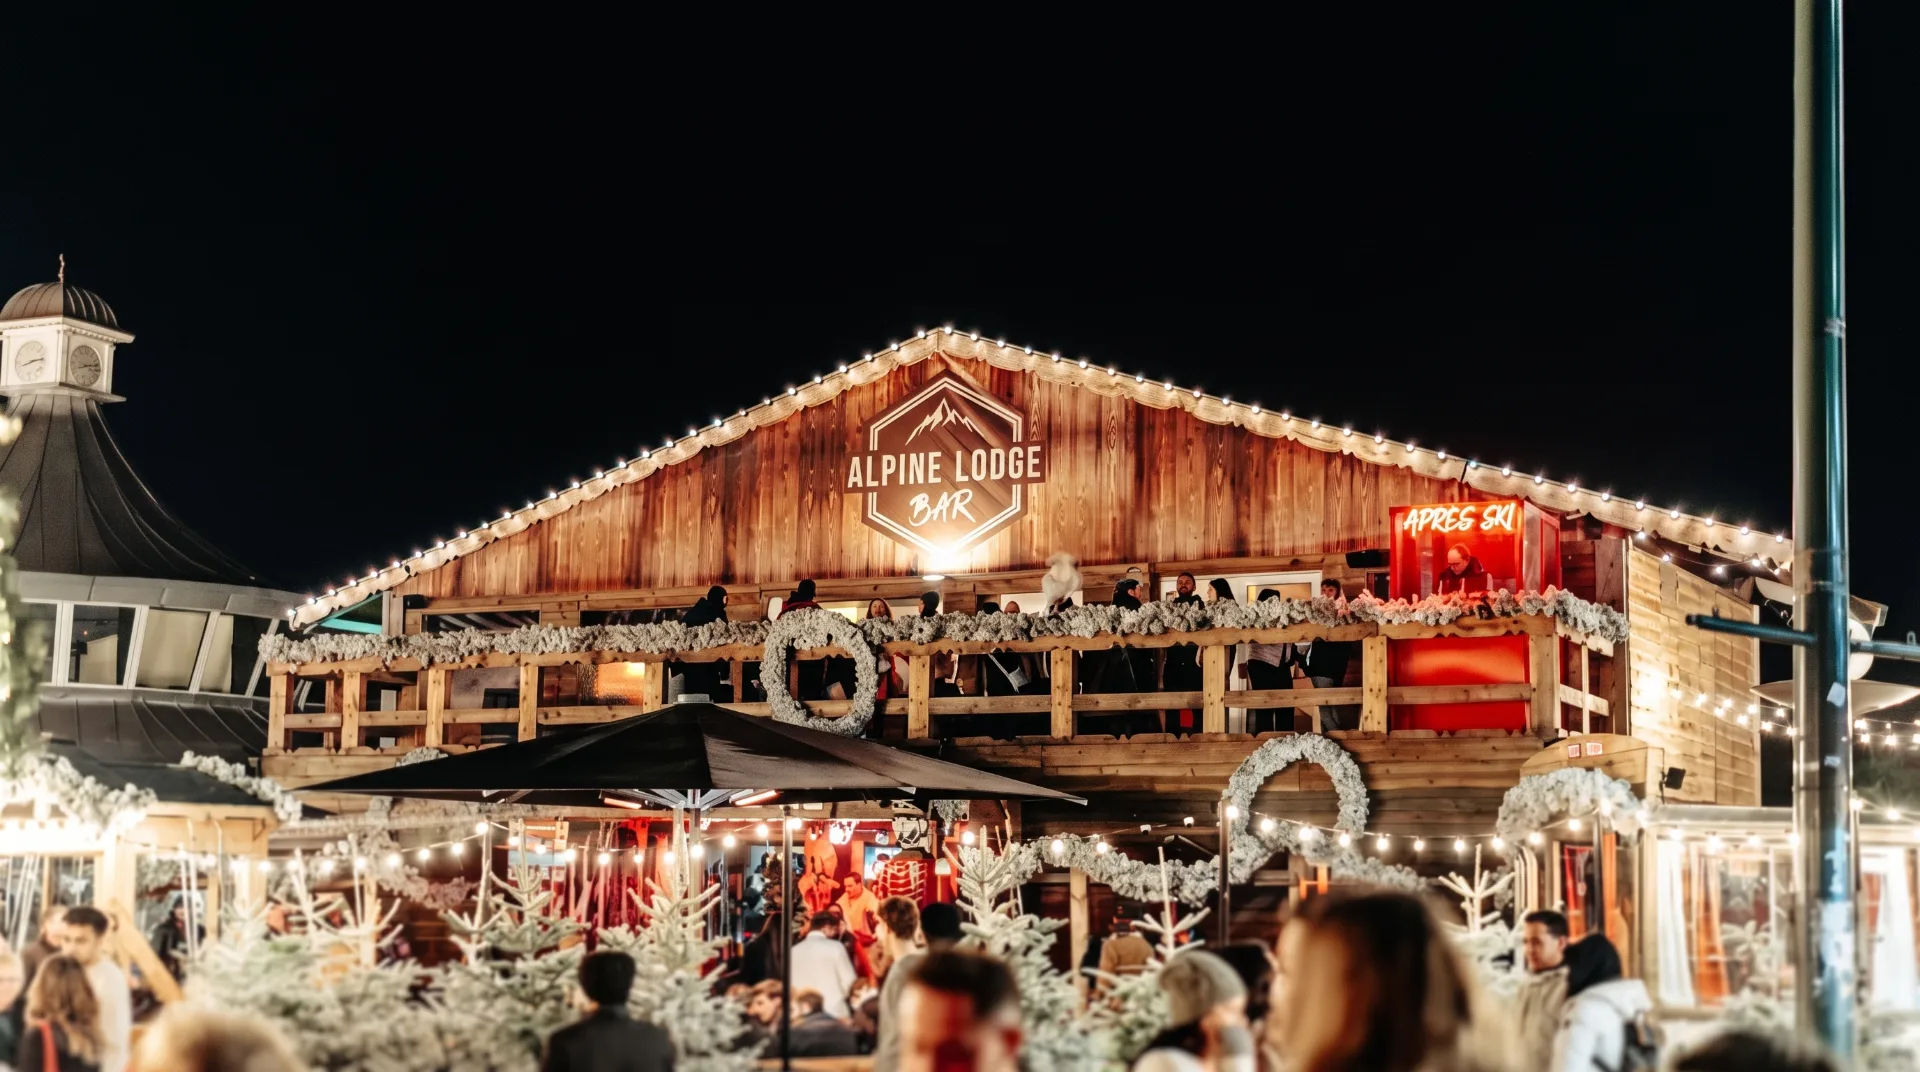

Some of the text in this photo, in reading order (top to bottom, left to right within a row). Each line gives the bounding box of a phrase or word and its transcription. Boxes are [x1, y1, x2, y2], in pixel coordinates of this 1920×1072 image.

[847, 445, 1041, 488] ALPINE LODGE
[908, 488, 976, 527] BAR
[1480, 502, 1516, 531] SKI
